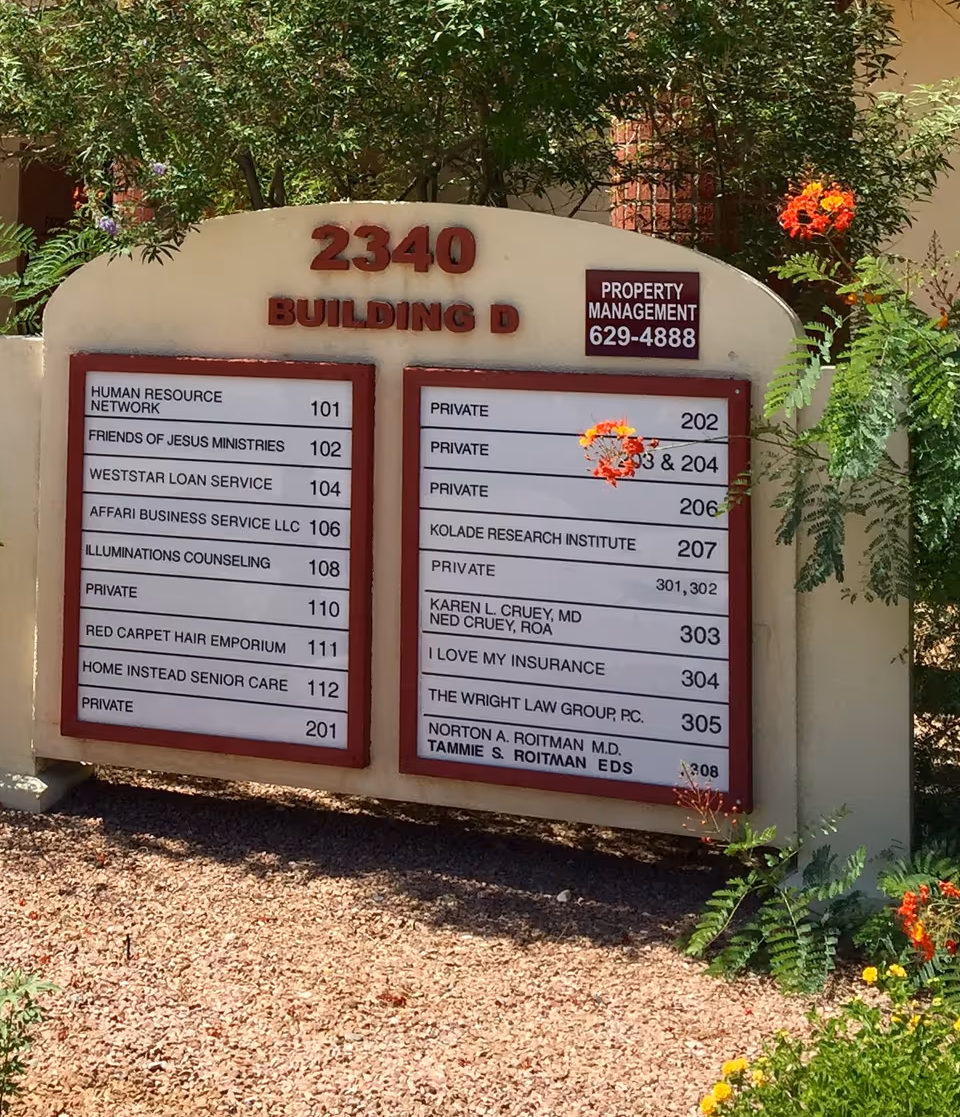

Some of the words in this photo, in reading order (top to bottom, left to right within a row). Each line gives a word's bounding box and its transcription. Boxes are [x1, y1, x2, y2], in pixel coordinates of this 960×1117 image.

[309, 224, 477, 274] 2340
[600, 281, 683, 301] PROPERTY
[267, 297, 476, 334] BUILDING
[489, 303, 520, 334] D
[588, 301, 697, 322] MANAGEMENT
[588, 325, 696, 349] 629-4888
[91, 386, 140, 399] HUMAN
[144, 389, 223, 403] RESOURCE
[90, 400, 160, 415] NETWORK
[310, 401, 340, 417] 101
[430, 402, 490, 418] PRIVATE
[680, 412, 719, 431] 202
[88, 429, 143, 444] FRIENDS
[146, 433, 164, 445] OF
[166, 434, 209, 448] JESUS
[212, 437, 286, 453] MINISTRIES
[310, 440, 342, 458] 102
[430, 441, 490, 457] PRIVATE
[660, 453, 675, 471] &
[680, 455, 719, 474] 204
[90, 468, 165, 484] WESTSTAR
[169, 473, 207, 487] LOAN
[210, 475, 273, 491] SERVICE
[310, 480, 341, 497] 104
[429, 482, 489, 498] PRIVATE
[680, 497, 718, 518] 206
[90, 505, 136, 519] AFFARI
[140, 509, 207, 525] BUSINESS
[210, 514, 270, 530] SERVICE
[274, 519, 300, 533] LLC
[309, 519, 341, 537] 106
[430, 523, 485, 540] KOLADE
[488, 527, 562, 546] RESEARCH
[565, 533, 637, 552] INSTITUTE
[85, 544, 181, 563] ILLUMINATIONS
[184, 551, 271, 569] COUNSELING
[677, 539, 718, 560] 207
[308, 559, 340, 578] 108
[431, 560, 496, 577] PRIVATE
[86, 583, 138, 599] PRIVATE
[308, 600, 340, 618] 110
[430, 598, 481, 615] KAREN
[485, 603, 497, 616] L.
[500, 604, 554, 623] CRUEY,
[558, 609, 582, 624] MD
[429, 612, 460, 628] NED
[463, 615, 517, 634] CRUEY,
[520, 620, 553, 636] ROA
[86, 625, 114, 637] RED
[116, 626, 170, 642] CARPET
[174, 631, 206, 645] HAIR
[210, 635, 286, 655] EMPORIUM
[679, 625, 721, 646] 303
[308, 640, 337, 657] 111
[428, 646, 432, 660] I
[437, 647, 479, 664] LOVE
[482, 651, 506, 666] MY
[511, 654, 606, 676] INSURANCE
[82, 661, 123, 675] HOME
[127, 664, 186, 681] INSTEAD
[190, 671, 245, 688] SENIOR
[248, 676, 288, 692] CARE
[680, 669, 720, 690] 304
[307, 680, 339, 699] 112
[82, 697, 134, 713] PRIVATE
[428, 688, 457, 704] THE
[461, 691, 521, 710] WRIGHT
[524, 696, 557, 714] LAW
[560, 702, 616, 723] GROUP,
[620, 708, 645, 724] P.C.
[305, 720, 337, 739] 201
[681, 713, 722, 734] 305
[428, 722, 492, 741] NORTON
[495, 729, 509, 743] A.
[514, 731, 584, 752] ROITMAN
[591, 739, 622, 757] M.D.
[427, 739, 484, 758] TAMMIE
[492, 746, 505, 761] S.
[514, 749, 587, 769] ROITMAN
[598, 758, 634, 775] EDS
